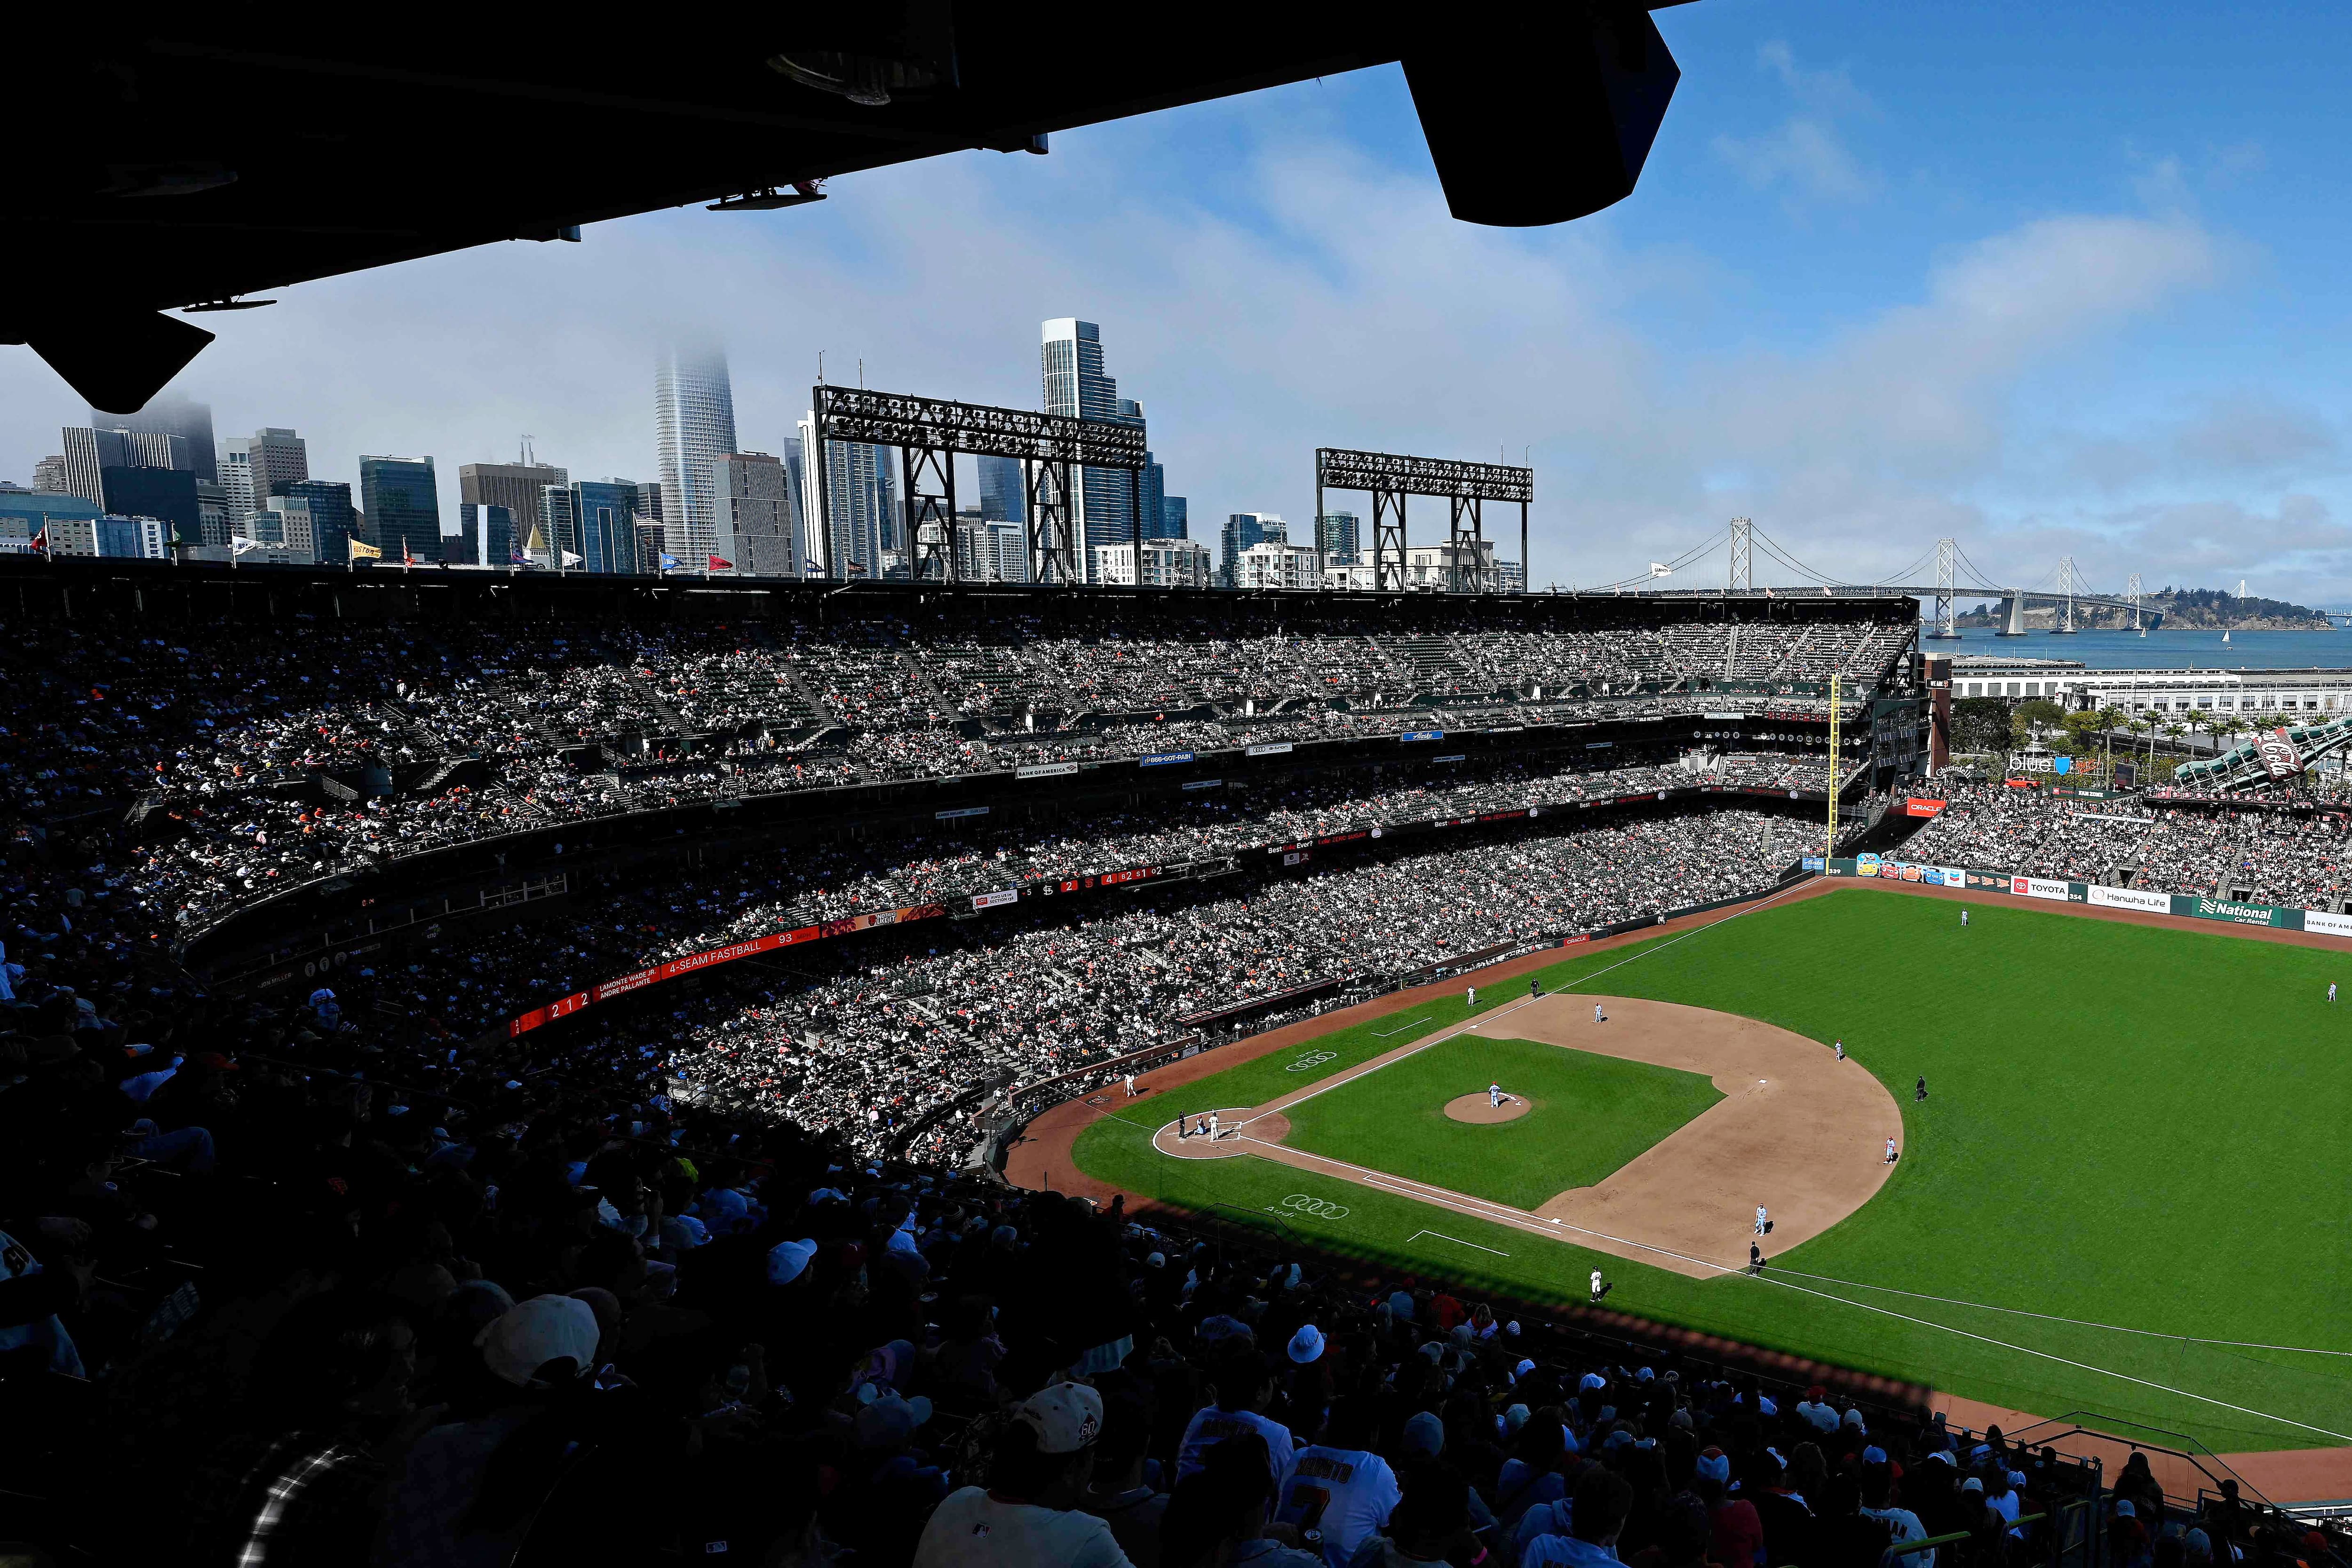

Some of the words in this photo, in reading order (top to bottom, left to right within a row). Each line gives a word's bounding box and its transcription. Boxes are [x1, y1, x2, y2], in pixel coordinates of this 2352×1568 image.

[1150, 753, 1191, 763] 866-GOT-PAIN
[2009, 753, 2051, 772] blue
[2261, 742, 2299, 776] Cola
[1936, 764, 1973, 779] Ghirardelli
[1066, 882, 1072, 891] 2
[1106, 874, 1112, 883] 4
[2031, 884, 2065, 894] TOYOTA
[2107, 893, 2145, 904] Hanwha
[2148, 898, 2166, 907] Life
[2216, 903, 2273, 920] National
[779, 934, 792, 944] 93
[796, 932, 811, 941] MPH
[669, 954, 708, 973] 4-SEAM
[710, 942, 761, 962] FASTBALL
[600, 978, 628, 991] LAMONTE
[629, 972, 646, 984] WADE
[648, 969, 656, 979] JR.
[600, 986, 620, 999] ANDRE
[620, 977, 651, 991] PALLANTE
[552, 1005, 559, 1018] 2
[566, 999, 572, 1011] 1
[581, 993, 588, 1006] 2
[1211, 994, 1263, 1012] FRANCISCO
[1175, 1010, 1212, 1022] GIANTS
[1296, 1048, 1319, 1059] Audi
[1263, 1205, 1297, 1218] Audi
[1081, 1421, 1095, 1435] 60
[1291, 1484, 1330, 1529] 7
